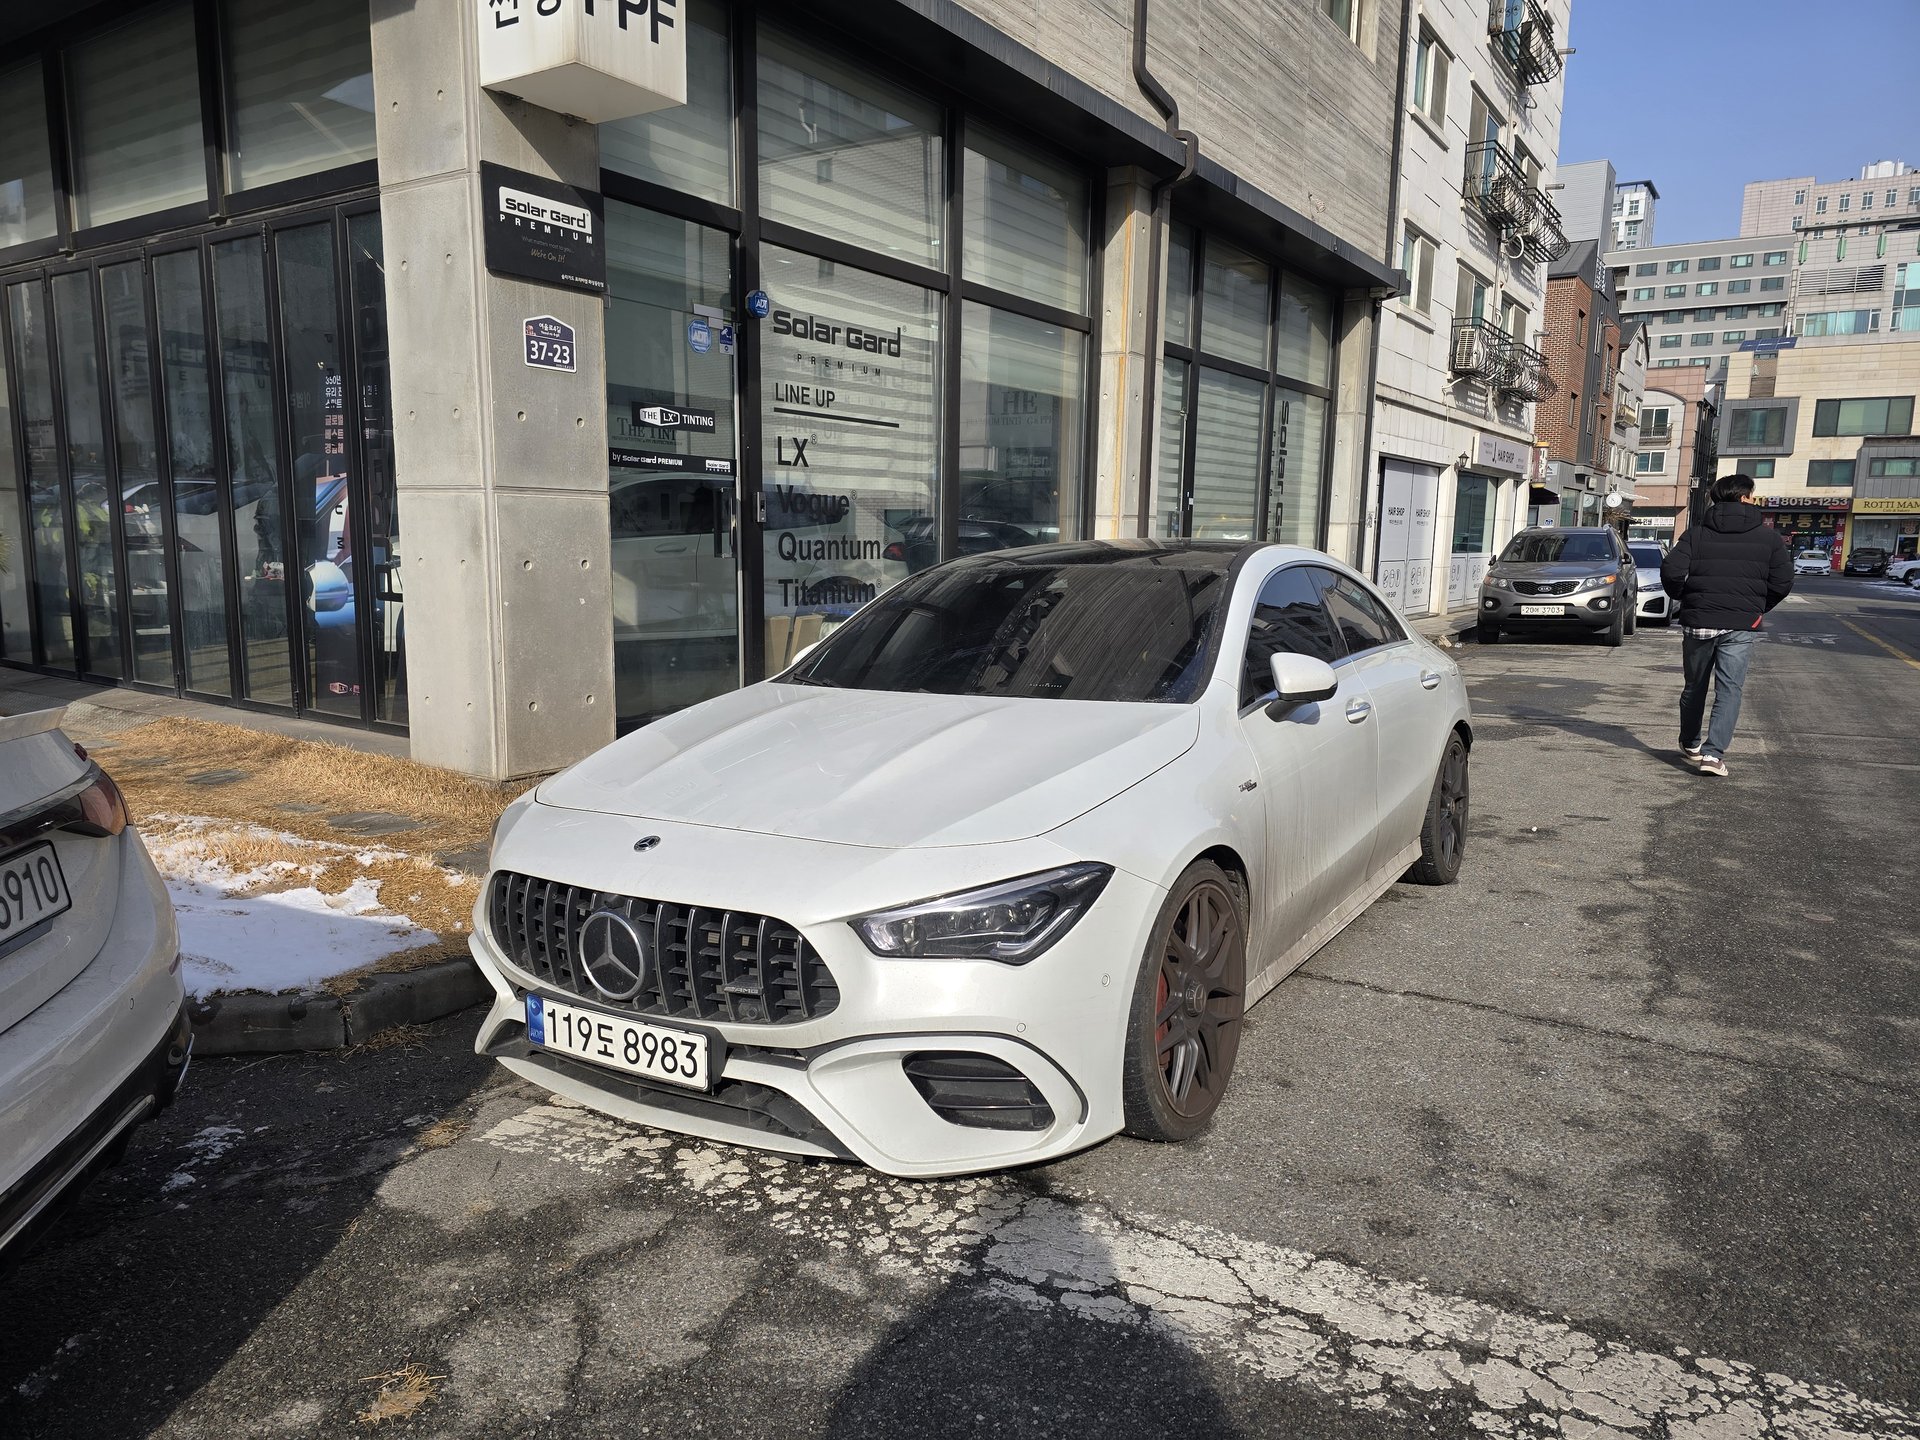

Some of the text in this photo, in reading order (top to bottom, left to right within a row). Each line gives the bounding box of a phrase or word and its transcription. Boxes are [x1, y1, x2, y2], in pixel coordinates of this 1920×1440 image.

[505, 198, 586, 228] Solar Gard
[500, 213, 592, 244] PREMIUM
[547, 252, 557, 261] On
[756, 299, 768, 310] ADT
[773, 310, 901, 358] Solar Gard
[530, 340, 570, 364] 37-23
[797, 353, 881, 377] PREMIUM
[775, 382, 836, 408] LINE UP
[643, 410, 658, 420] THE
[682, 414, 714, 426] TINTING
[612, 452, 683, 466] by Solar Gard PREMIUM
[1278, 400, 1290, 495] Solar
[776, 484, 850, 519] Vogue
[1781, 497, 1848, 506] 8015-1253
[1777, 514, 1835, 528] 부동산
[778, 531, 881, 562] Quantum
[778, 578, 876, 608] Titanium
[1542, 606, 1560, 614] 3703
[548, 1008, 698, 1079] 119도 8983
